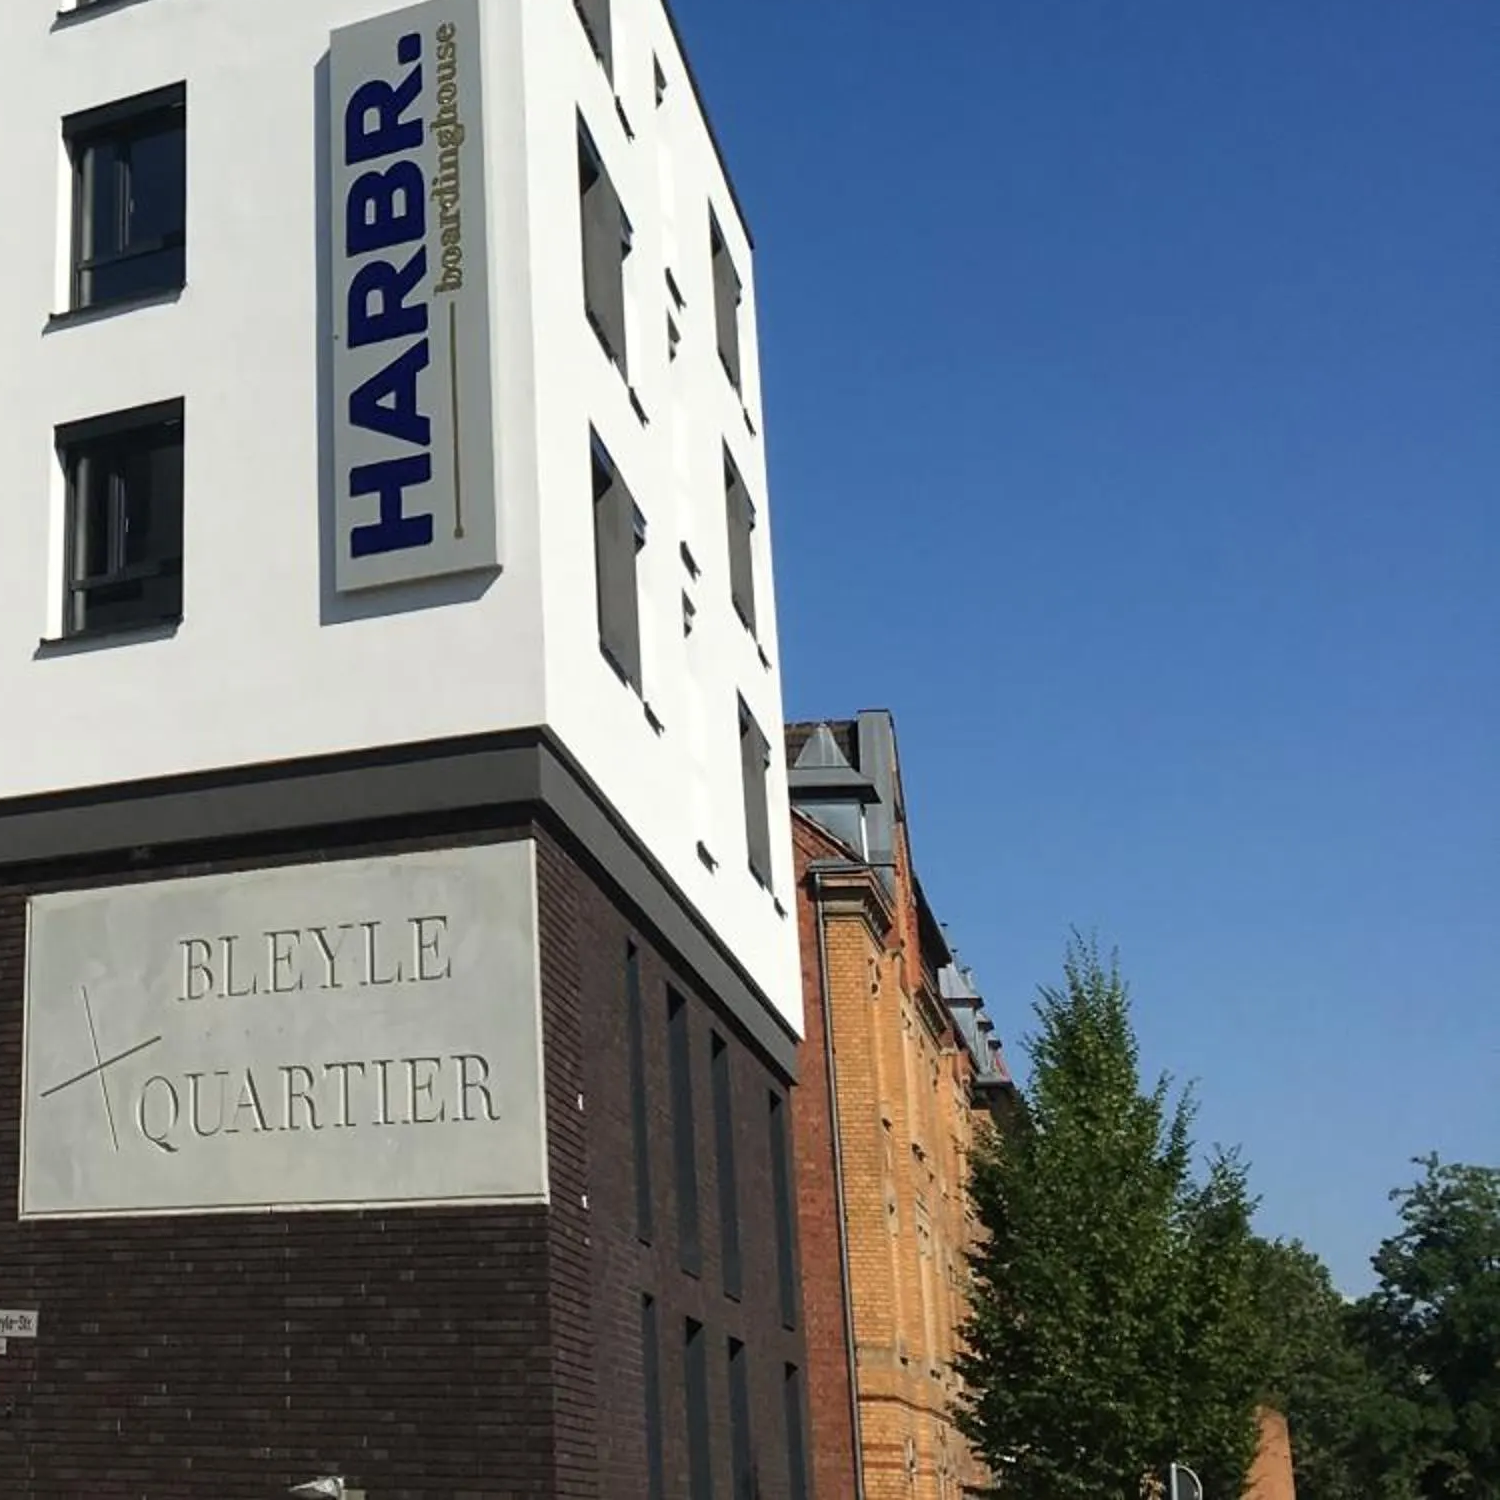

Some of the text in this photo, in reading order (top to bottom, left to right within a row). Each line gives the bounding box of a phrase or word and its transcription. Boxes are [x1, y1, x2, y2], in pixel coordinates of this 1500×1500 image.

[430, 20, 465, 297] boardinghouse
[345, 32, 433, 559] HARBR.
[177, 915, 452, 1002] BLEYLE
[134, 1053, 501, 1153] QUARTIER
